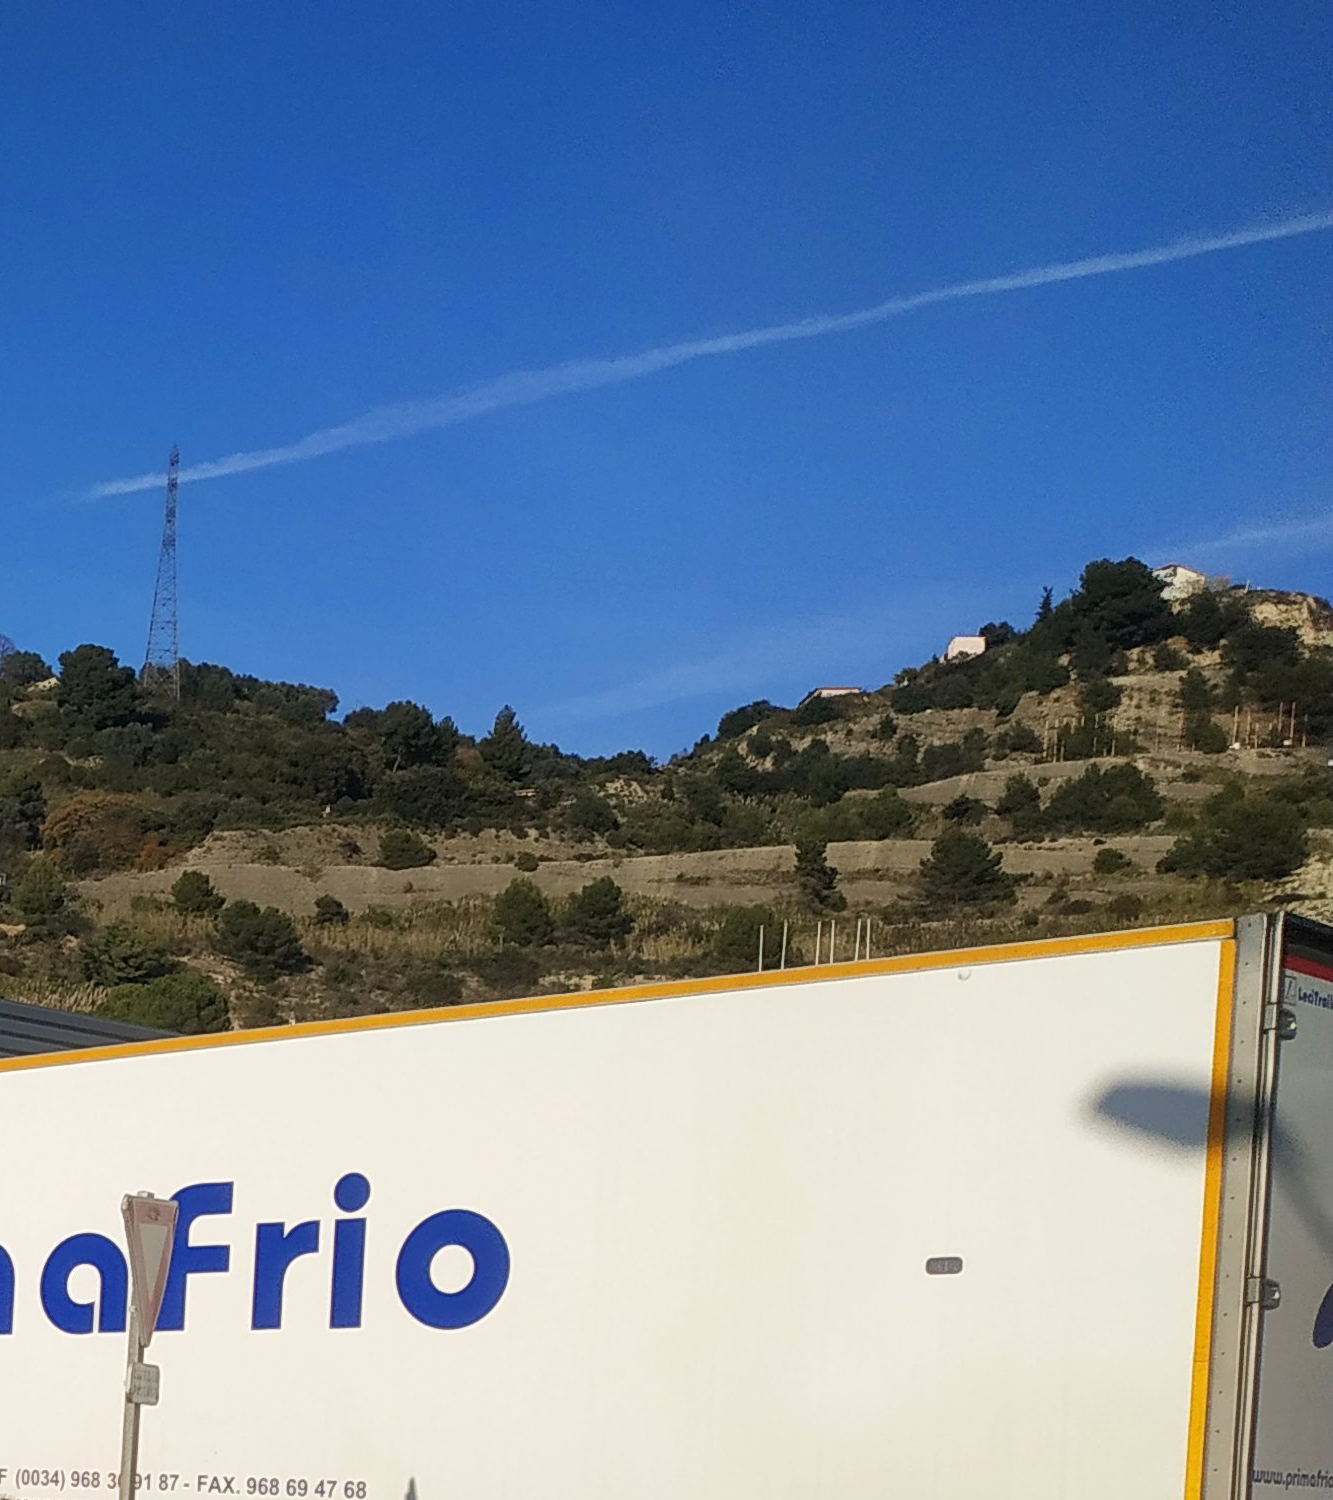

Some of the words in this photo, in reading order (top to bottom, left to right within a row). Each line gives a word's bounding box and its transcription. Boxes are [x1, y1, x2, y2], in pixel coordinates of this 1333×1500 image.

[15, 1468, 66, 1491] (0034)
[70, 1470, 101, 1489] 968
[158, 1473, 180, 1492] 87
[197, 1474, 241, 1495] FAX.
[246, 1476, 280, 1496] 968
[285, 1478, 309, 1498] 69
[314, 1479, 338, 1499] 47
[343, 1480, 368, 1500] 68
